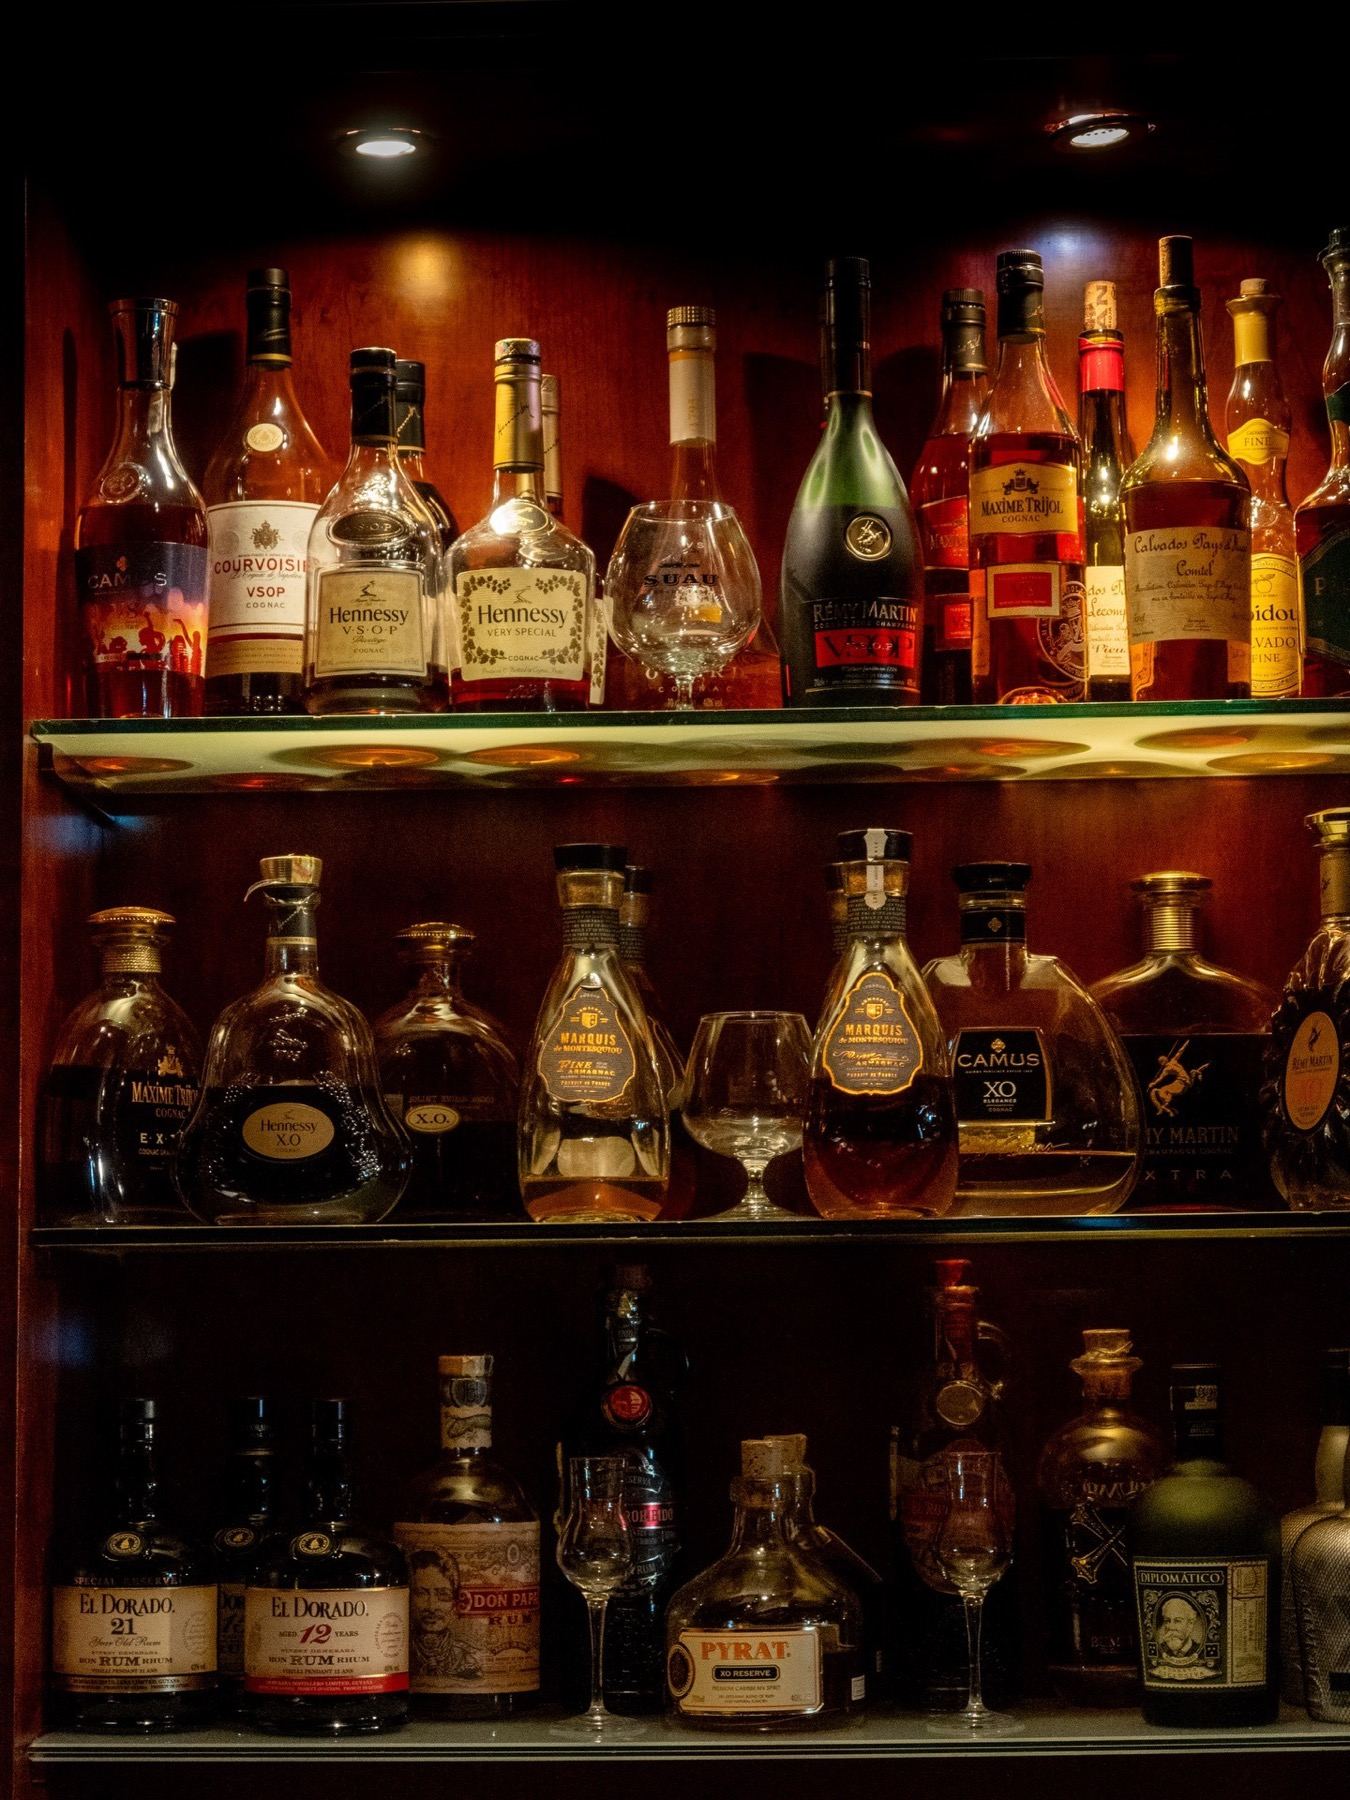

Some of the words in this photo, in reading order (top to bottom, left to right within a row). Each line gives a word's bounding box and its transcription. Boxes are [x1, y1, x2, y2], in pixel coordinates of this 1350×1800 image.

[1244, 437, 1274, 447] FINE
[981, 499, 1024, 517] MAXIME
[1001, 514, 1041, 523] COGNAC
[1134, 534, 1188, 554] Calvados
[643, 573, 719, 587] SUAU
[246, 586, 286, 597] VSOP
[246, 601, 286, 609] COGNAC
[862, 600, 919, 622] MARTIN
[330, 606, 409, 625] Hennessy
[478, 604, 569, 629] Hennessy
[488, 628, 512, 637] VERY
[515, 627, 557, 637] SPECIAL
[845, 1023, 903, 1037] MARQUIS
[560, 1032, 617, 1047] MARQUIS
[957, 1053, 1040, 1068] CAMUS
[131, 1081, 175, 1105] MAXIME
[983, 1080, 1017, 1098] XO
[416, 1113, 451, 1125] X.O.
[261, 1119, 318, 1134] Hennessy
[276, 1133, 302, 1147] X.O
[1168, 1125, 1241, 1145] MARTIN
[1144, 1169, 1233, 1181] XTRA
[1141, 1572, 1221, 1585] DIPLOMÁTICO
[80, 1593, 98, 1615] EL
[272, 1596, 290, 1618] EL
[473, 1594, 509, 1608] DON
[110, 1617, 138, 1635] 21
[300, 1623, 332, 1645] 12
[334, 1630, 359, 1638] YEARS
[80, 1657, 98, 1665] RON
[98, 1656, 142, 1667] RUM
[142, 1657, 173, 1665] RHUM
[289, 1655, 335, 1666] RUM
[720, 1670, 732, 1678] XO
[733, 1669, 772, 1678] RESERVE
